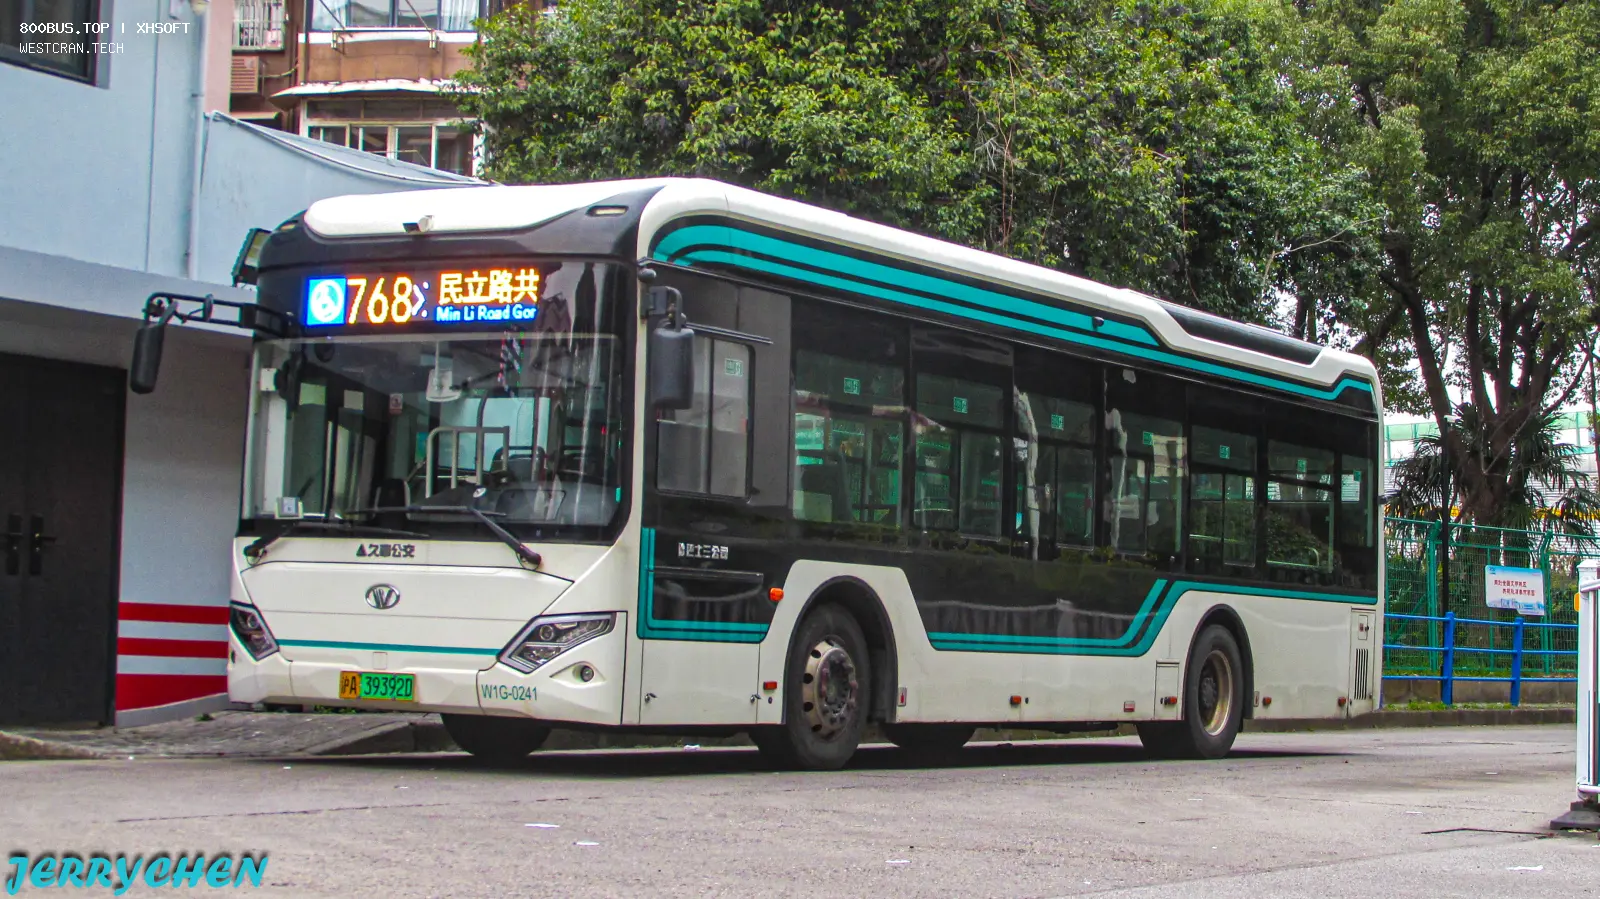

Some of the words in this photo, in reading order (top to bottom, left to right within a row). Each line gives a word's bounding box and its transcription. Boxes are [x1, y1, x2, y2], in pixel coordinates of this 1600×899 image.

[438, 268, 540, 305] 民立路共
[347, 276, 413, 324] 768
[436, 306, 461, 322] Min
[463, 305, 475, 321] Li
[477, 303, 510, 320] Road
[363, 675, 413, 697] 39392D
[481, 684, 538, 701] W1G-0241
